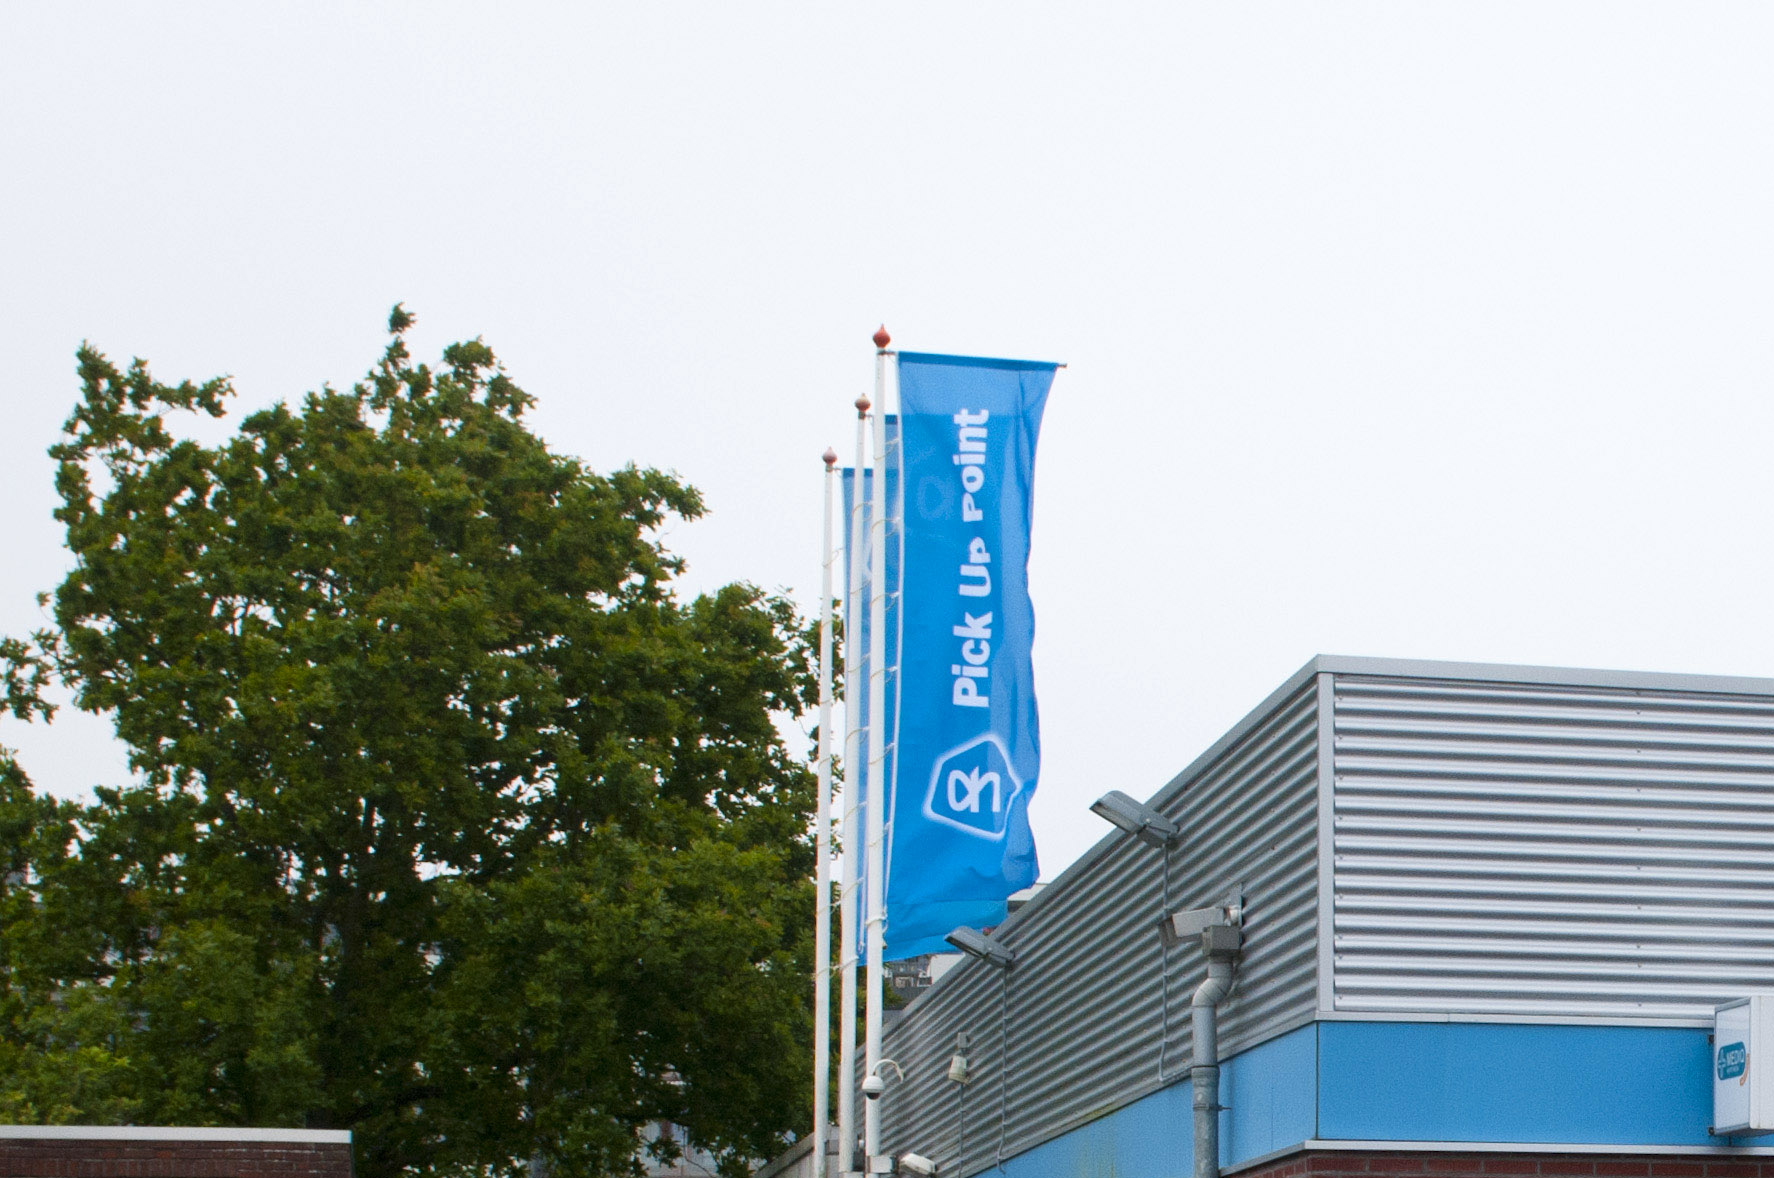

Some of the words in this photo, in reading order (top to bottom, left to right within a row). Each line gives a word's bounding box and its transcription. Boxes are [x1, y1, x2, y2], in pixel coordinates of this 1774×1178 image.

[952, 408, 990, 523] Point
[958, 536, 992, 598] Up
[951, 611, 994, 708] Pick
